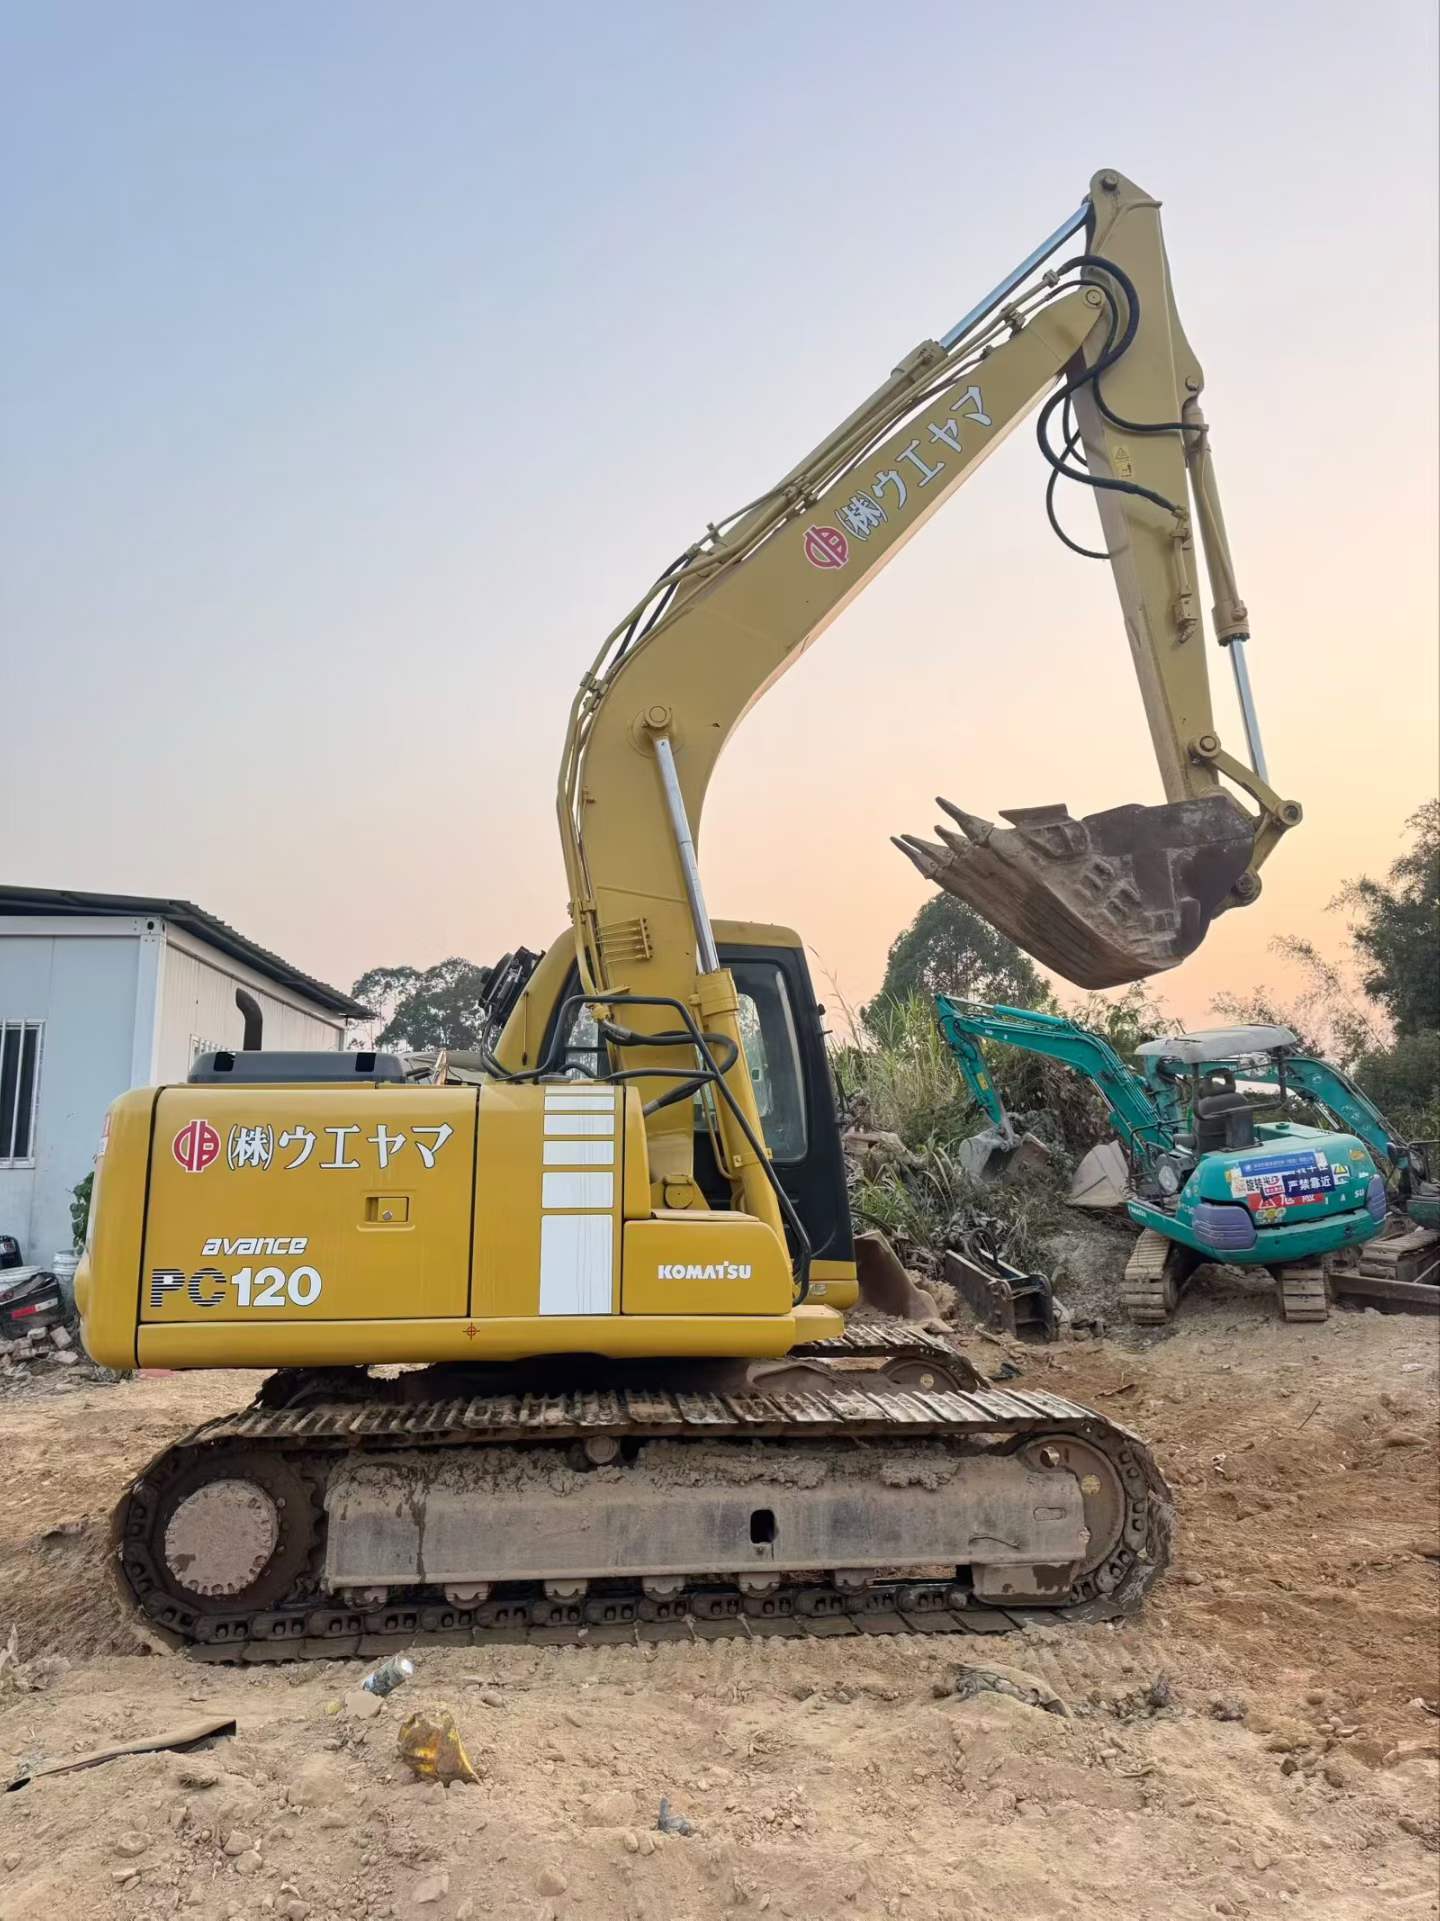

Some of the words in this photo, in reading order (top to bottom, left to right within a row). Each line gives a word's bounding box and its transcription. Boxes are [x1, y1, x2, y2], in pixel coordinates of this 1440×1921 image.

[226, 1121, 455, 1171] (株)ウエヤマ
[1287, 1175, 1332, 1192] 严禁靠近
[201, 1237, 309, 1256] avance
[658, 1261, 752, 1280] KOMATSU
[151, 1265, 323, 1308] PC120
